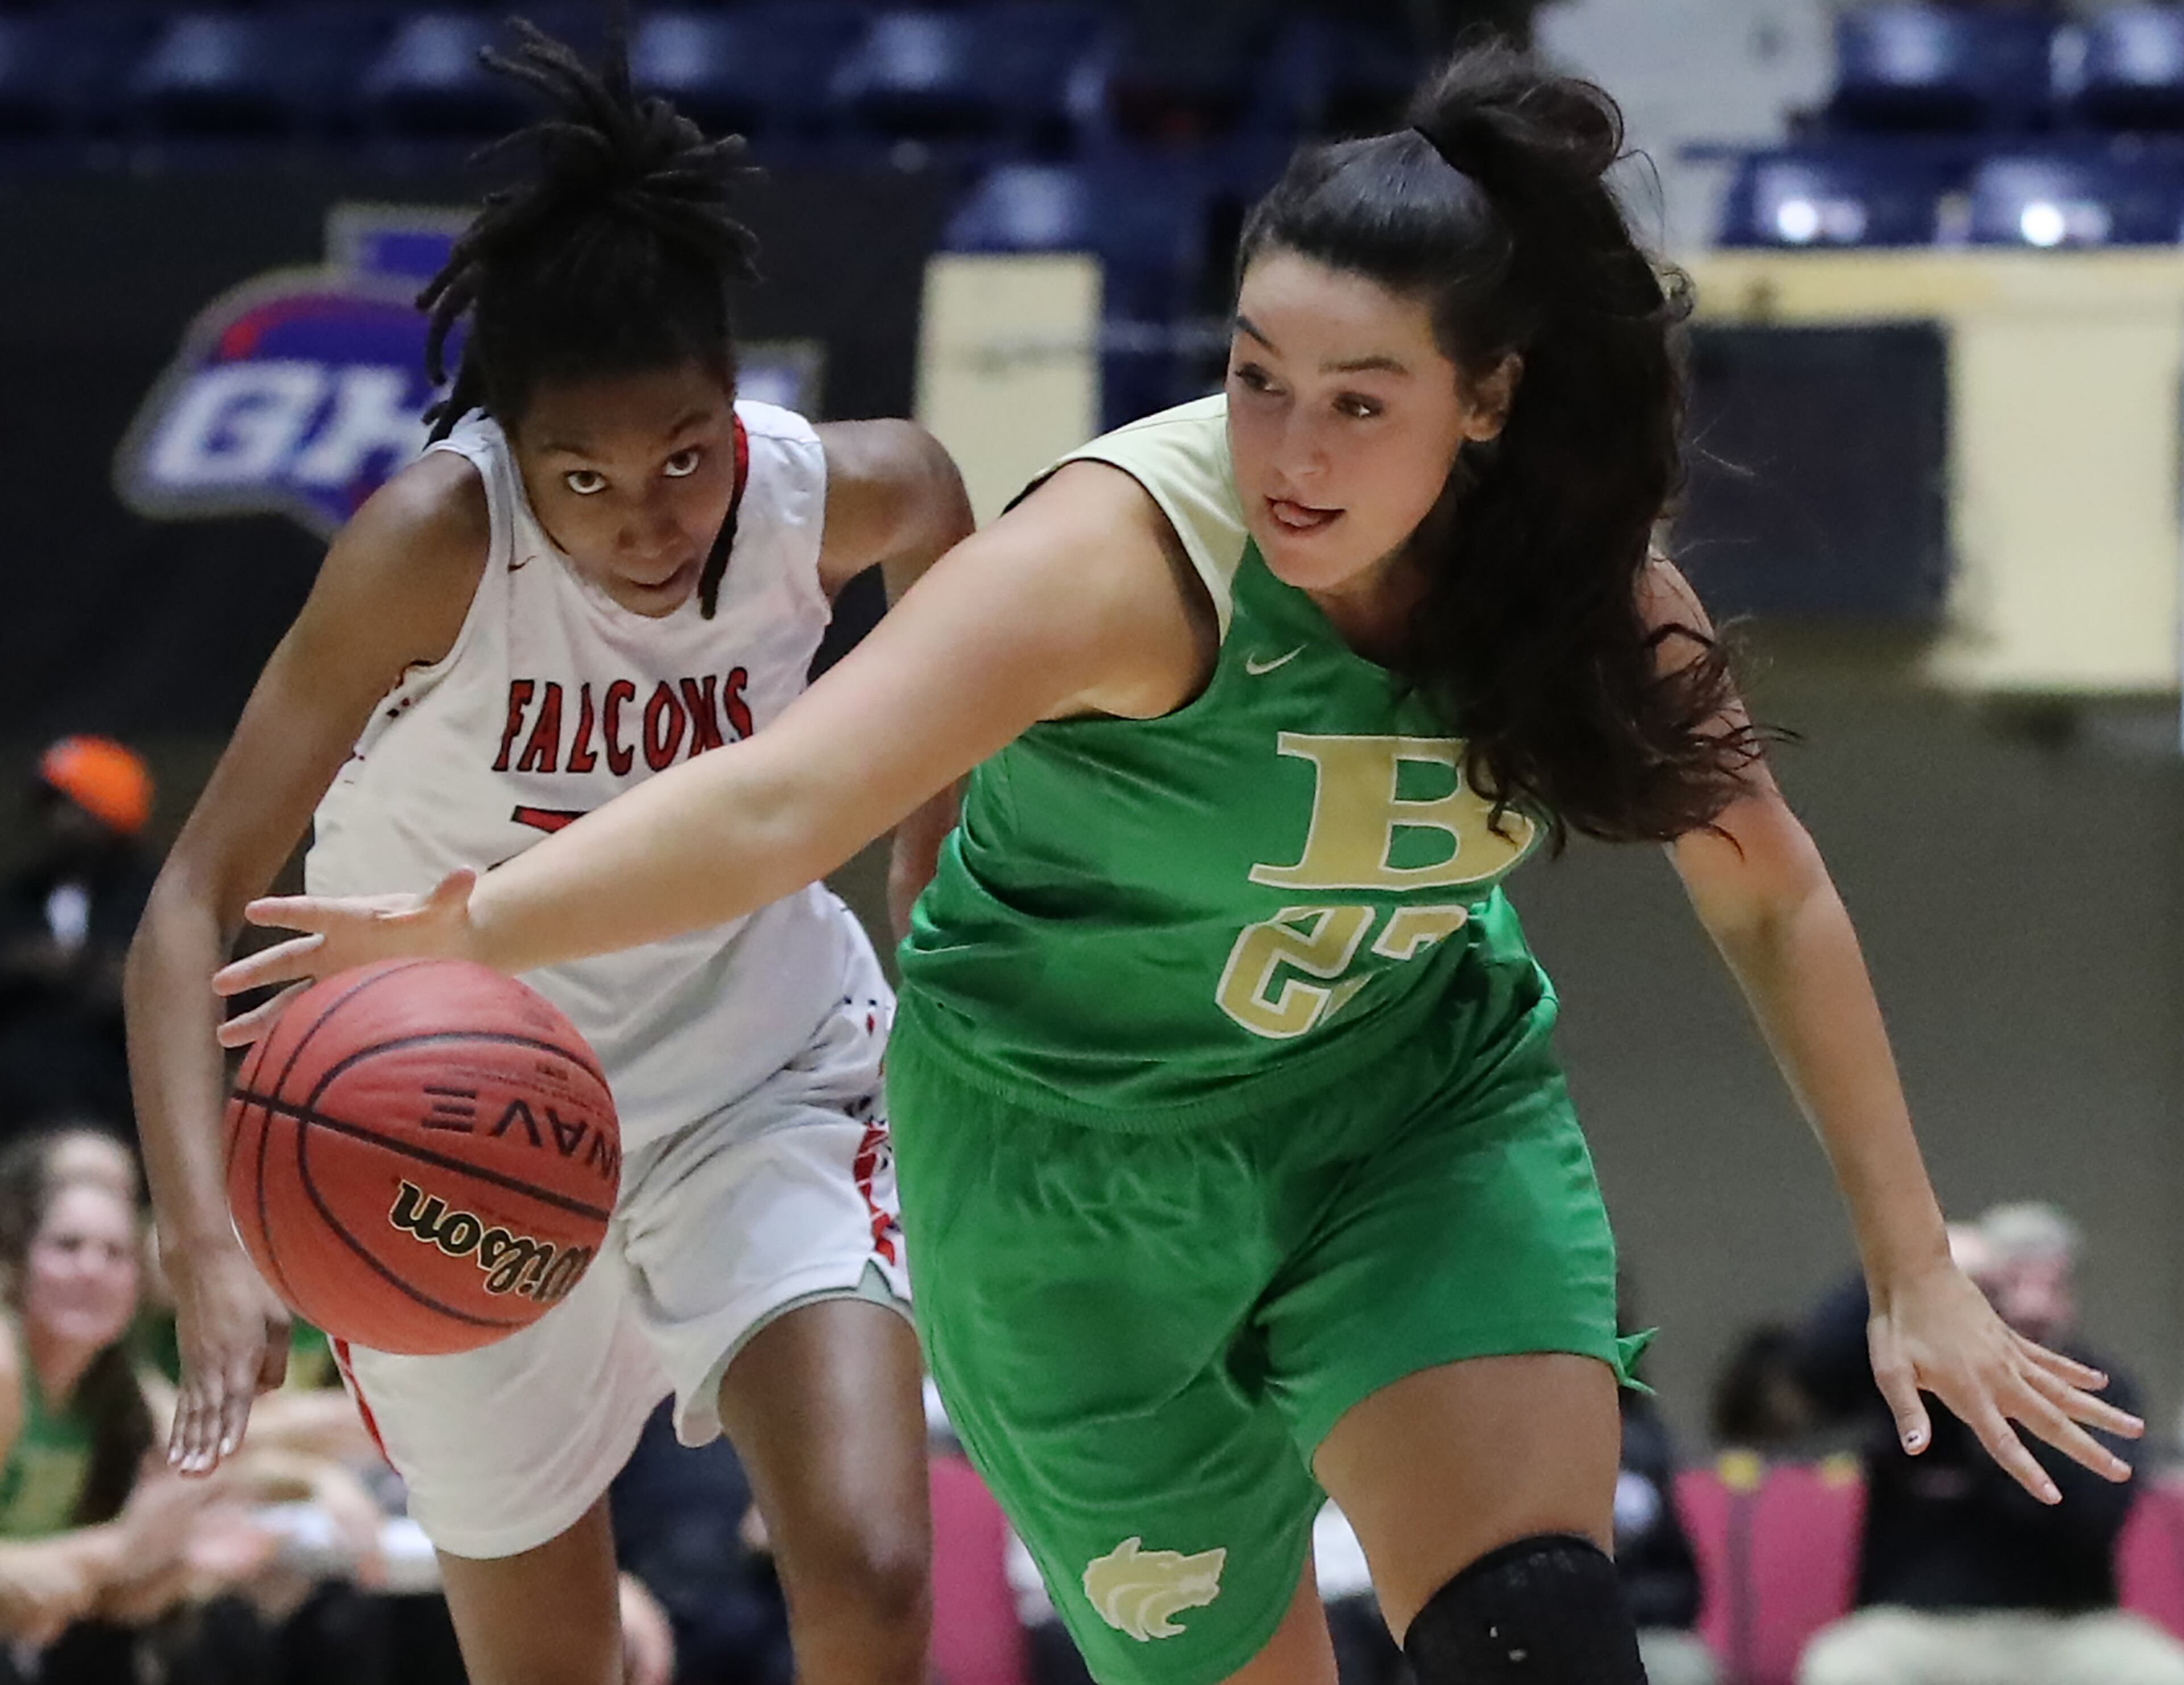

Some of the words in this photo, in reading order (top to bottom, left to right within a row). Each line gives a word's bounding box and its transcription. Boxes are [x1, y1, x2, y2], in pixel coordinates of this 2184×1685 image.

[491, 666, 753, 776] FALCONS
[1248, 730, 1536, 892] B
[388, 1179, 592, 1301] Wilson
